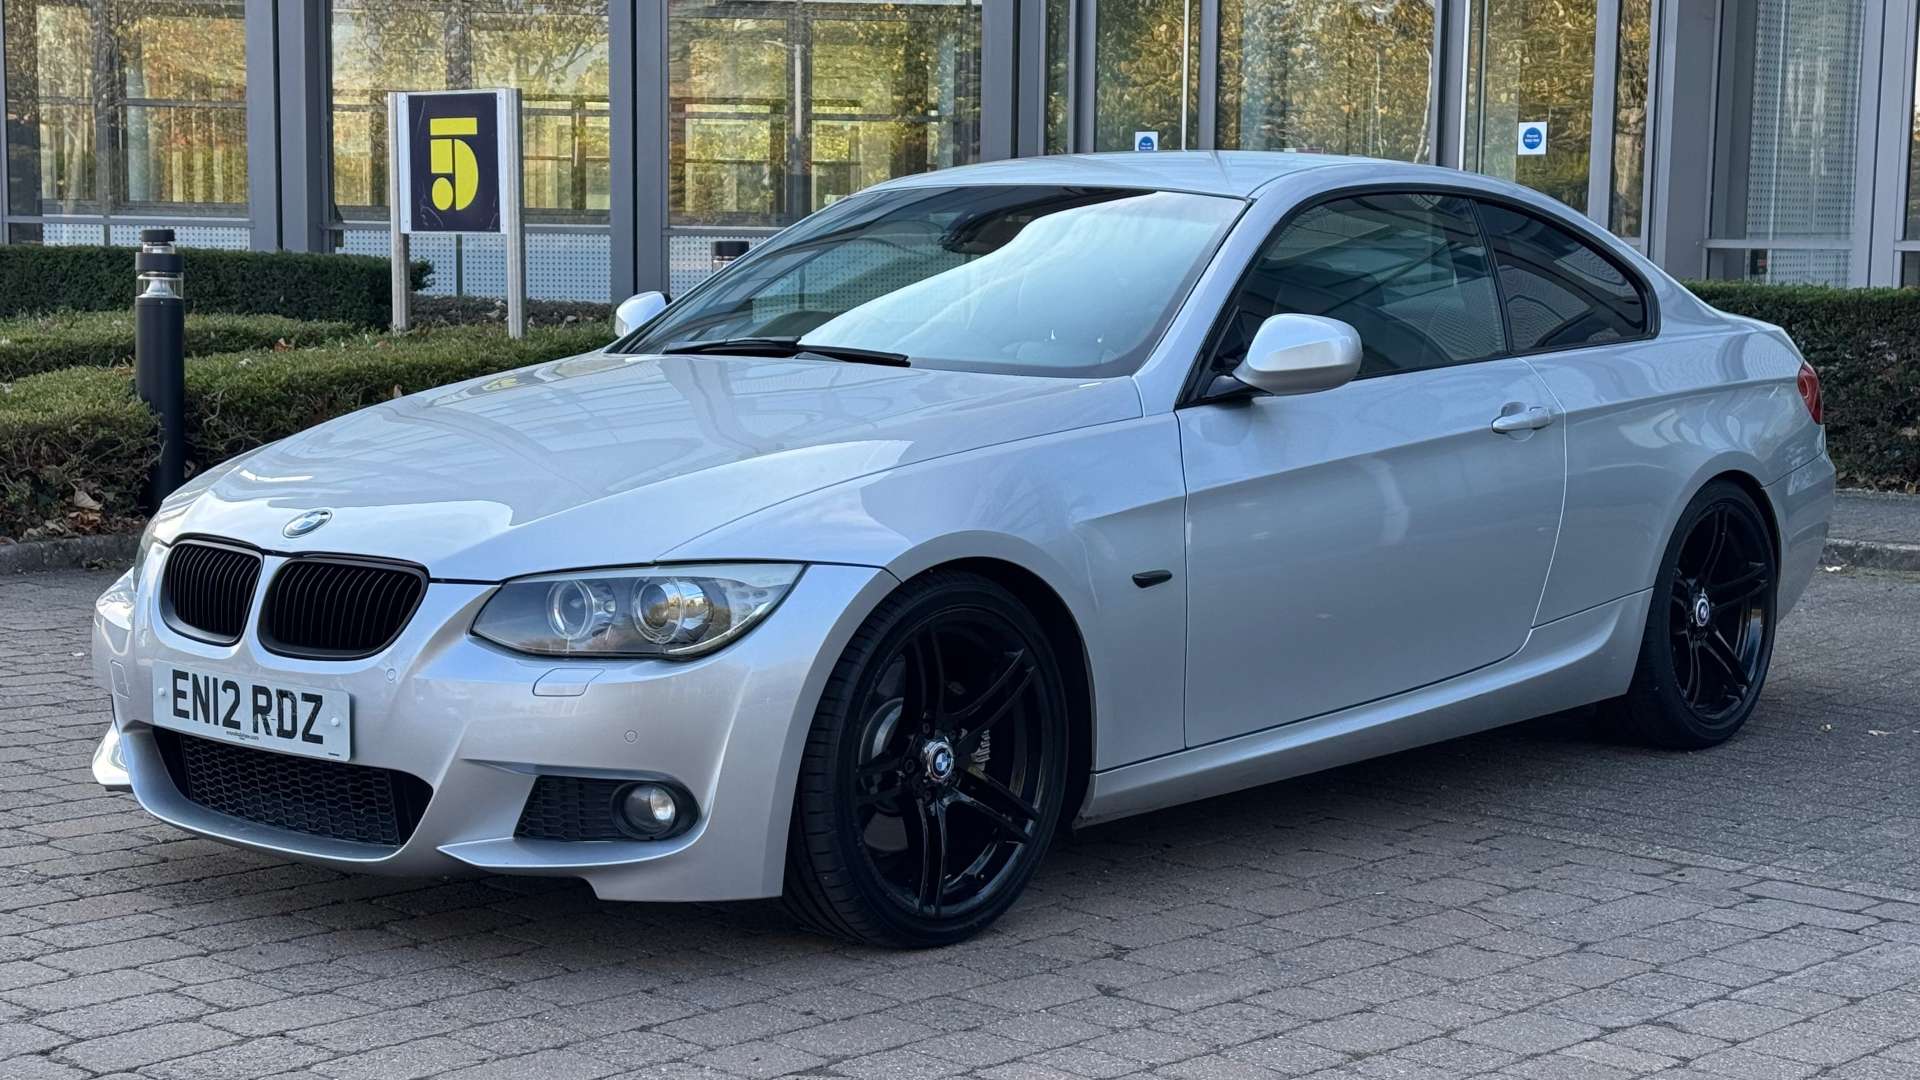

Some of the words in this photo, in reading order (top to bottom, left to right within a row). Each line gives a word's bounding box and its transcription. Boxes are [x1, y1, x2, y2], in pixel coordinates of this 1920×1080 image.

[430, 117, 479, 211] 5
[172, 669, 241, 730] EN12
[252, 684, 324, 745] RDZ
